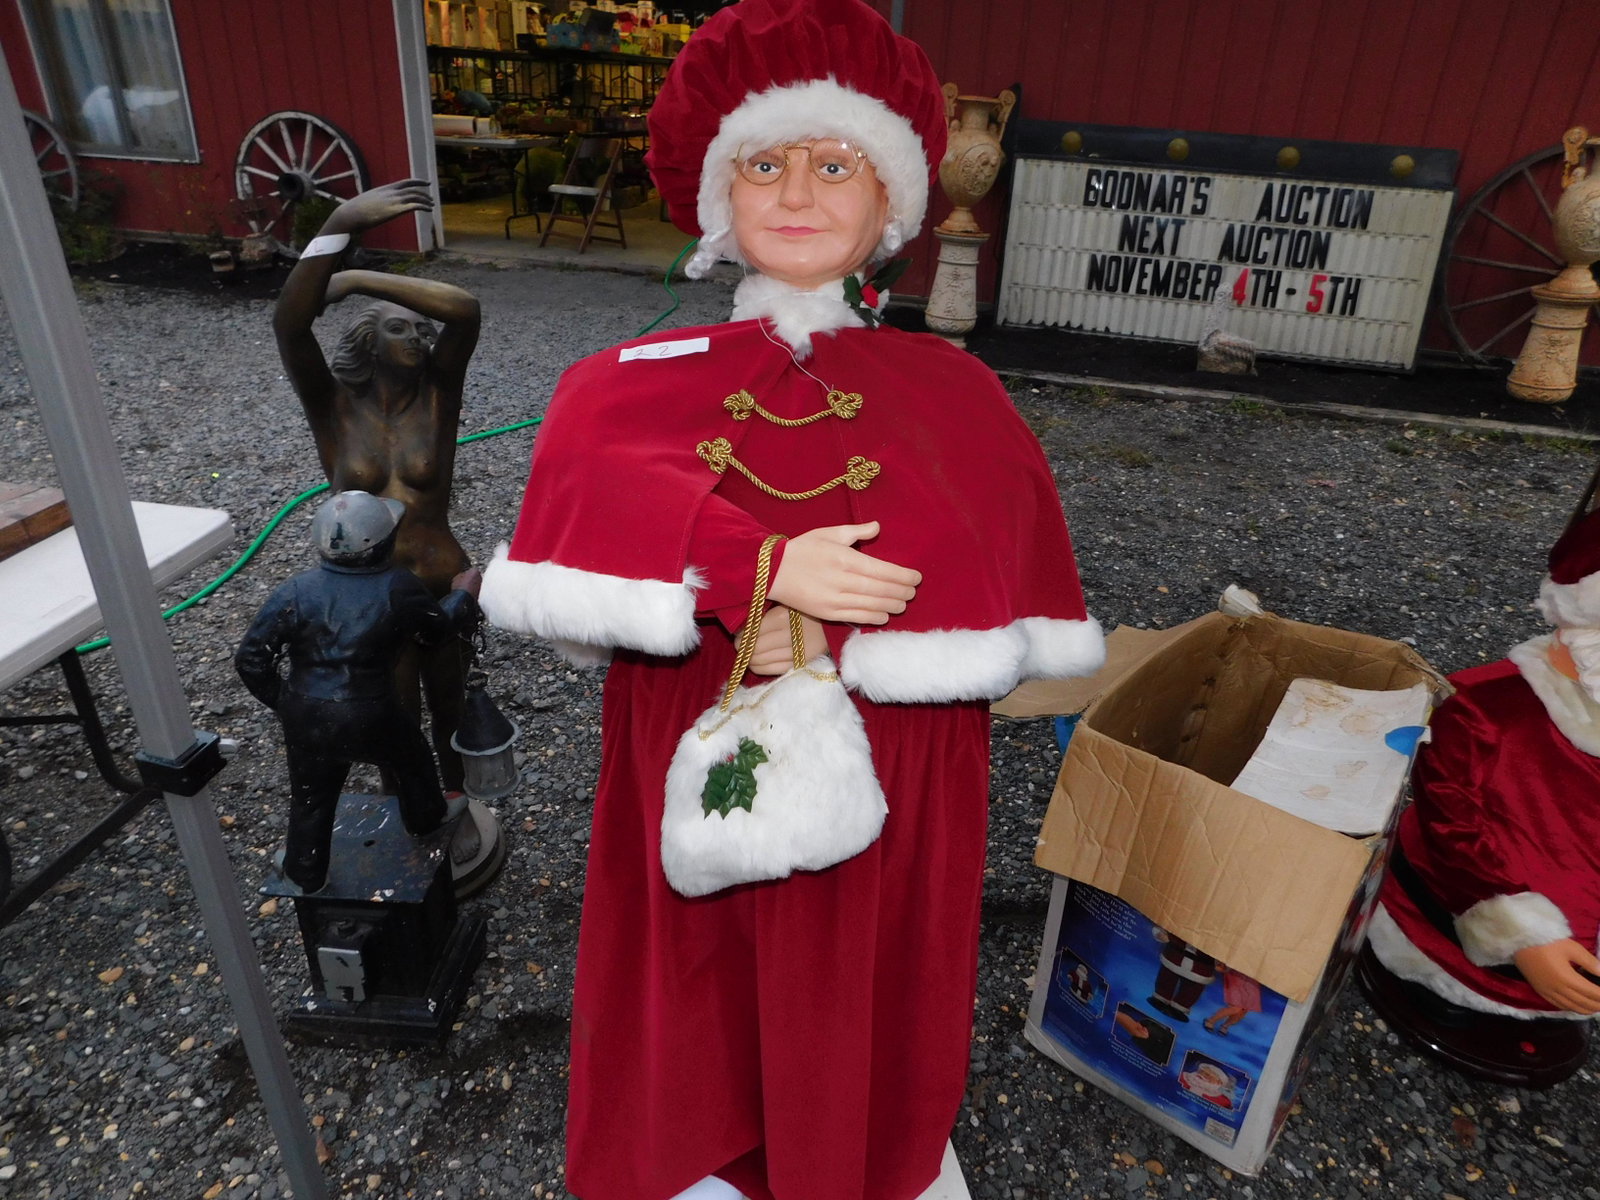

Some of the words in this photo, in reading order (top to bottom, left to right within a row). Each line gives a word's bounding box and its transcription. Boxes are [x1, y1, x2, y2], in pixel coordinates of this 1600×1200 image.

[1083, 168, 1211, 215] BODNAR'S
[1255, 182, 1375, 230] AUCTION
[1118, 214, 1186, 256] NEXT
[1217, 223, 1332, 270] AUCTION
[1087, 253, 1222, 303] NOVEMBER
